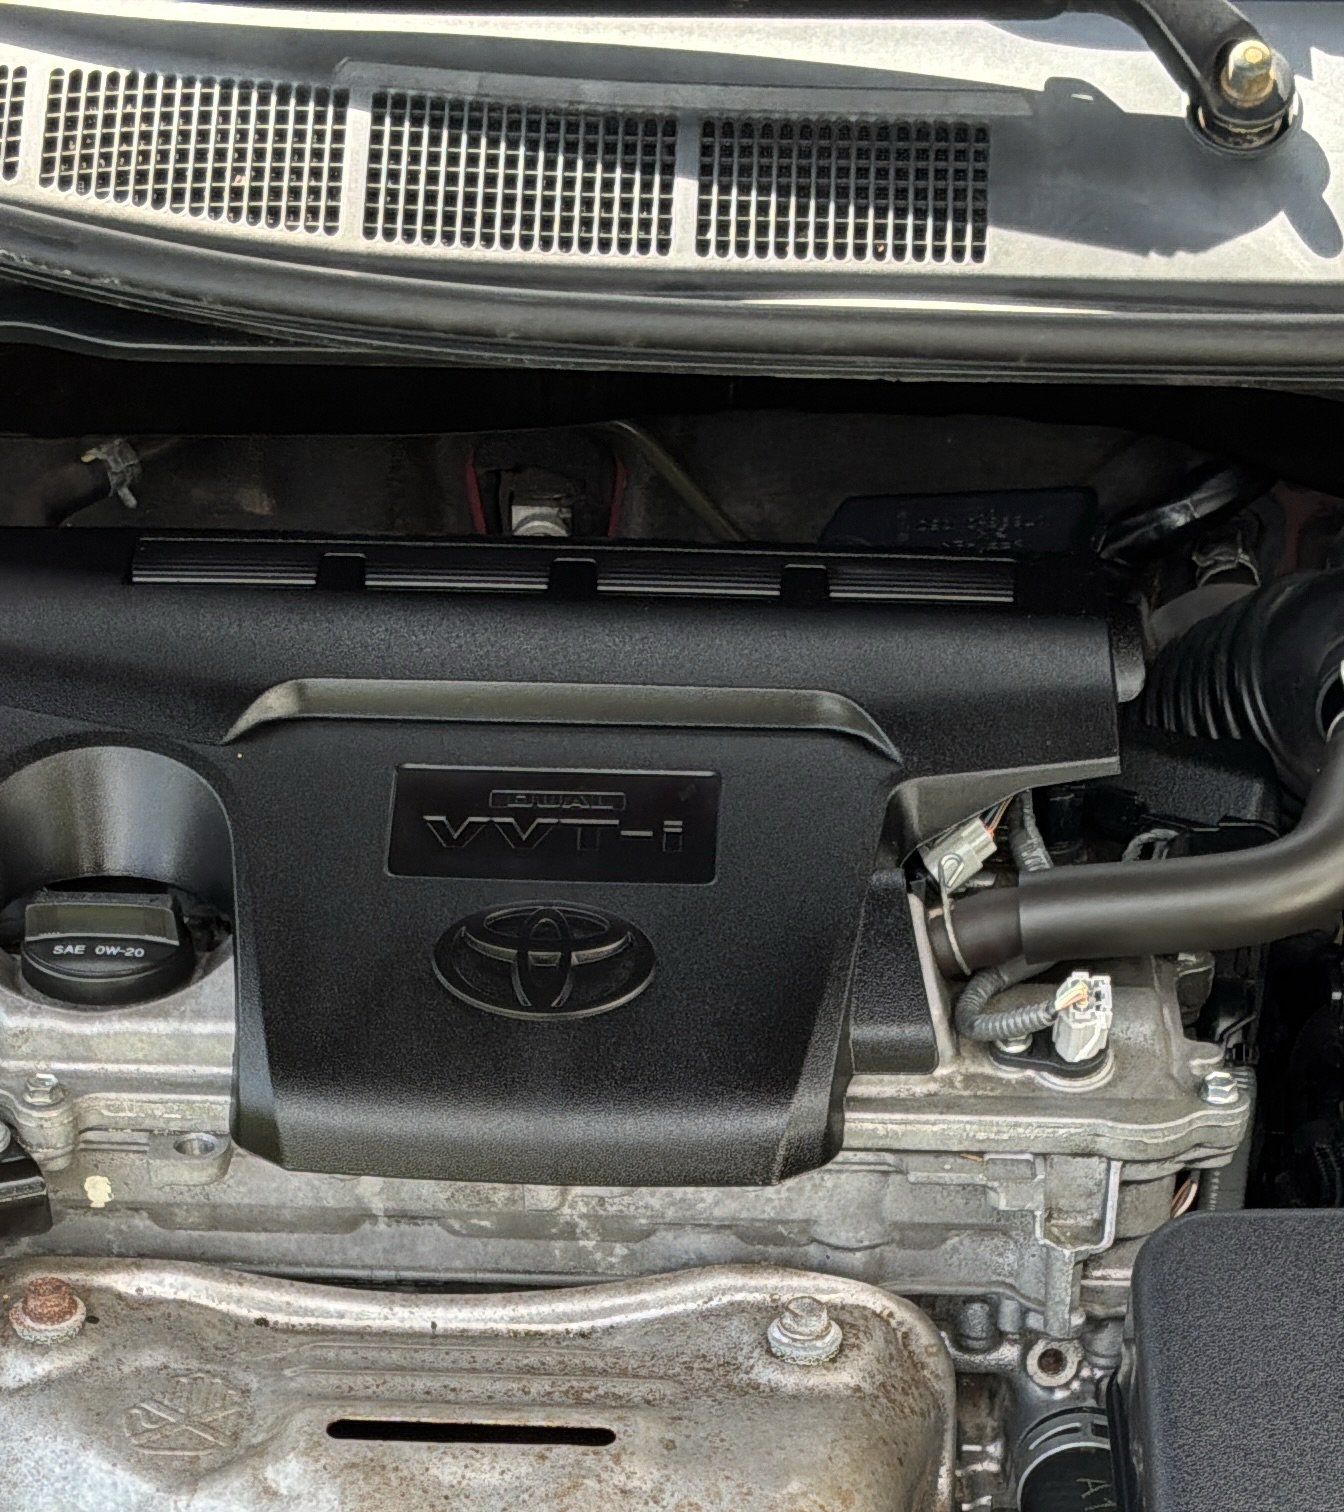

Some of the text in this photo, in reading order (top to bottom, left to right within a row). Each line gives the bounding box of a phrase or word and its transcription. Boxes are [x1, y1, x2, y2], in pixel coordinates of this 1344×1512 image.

[423, 815, 685, 853] VVT-i
[53, 944, 145, 958] SAE 0W-20
